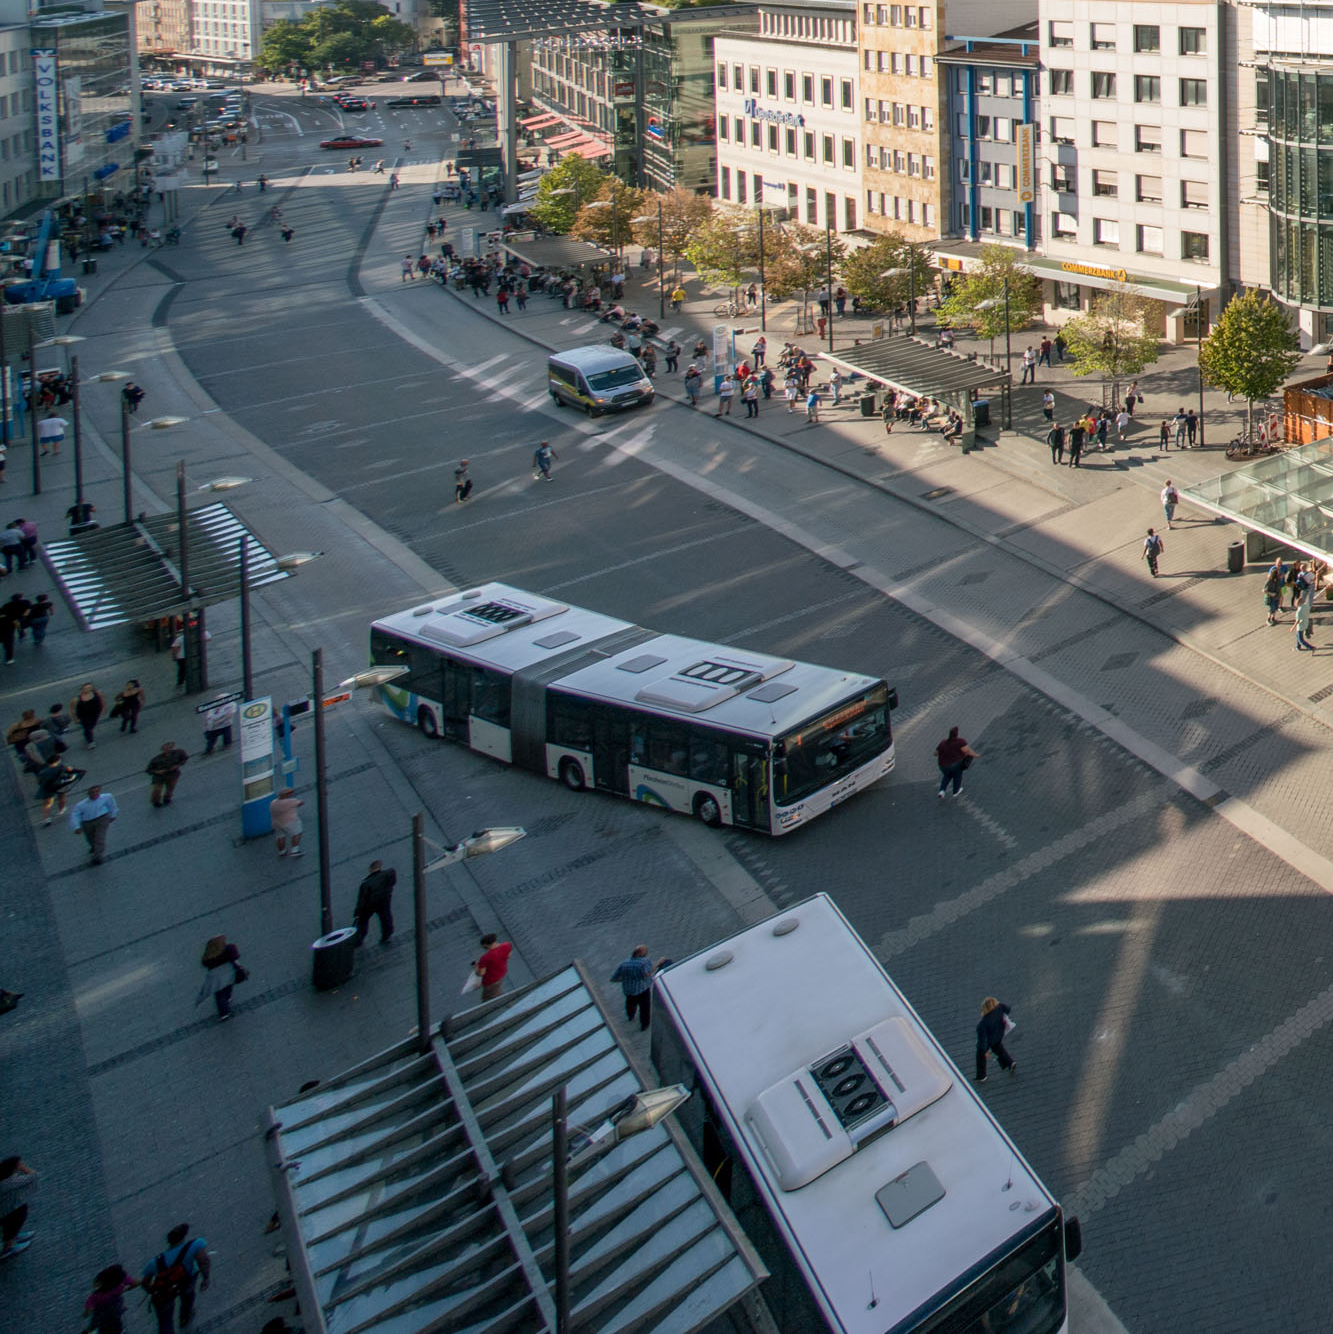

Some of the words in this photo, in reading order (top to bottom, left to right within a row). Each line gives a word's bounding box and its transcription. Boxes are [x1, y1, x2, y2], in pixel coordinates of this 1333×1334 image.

[37, 64, 56, 175] VOLKSBANK
[1022, 127, 1031, 187] COMMERZBANK
[1061, 261, 1115, 279] COMMERZBANK
[832, 781, 856, 797] MAN
